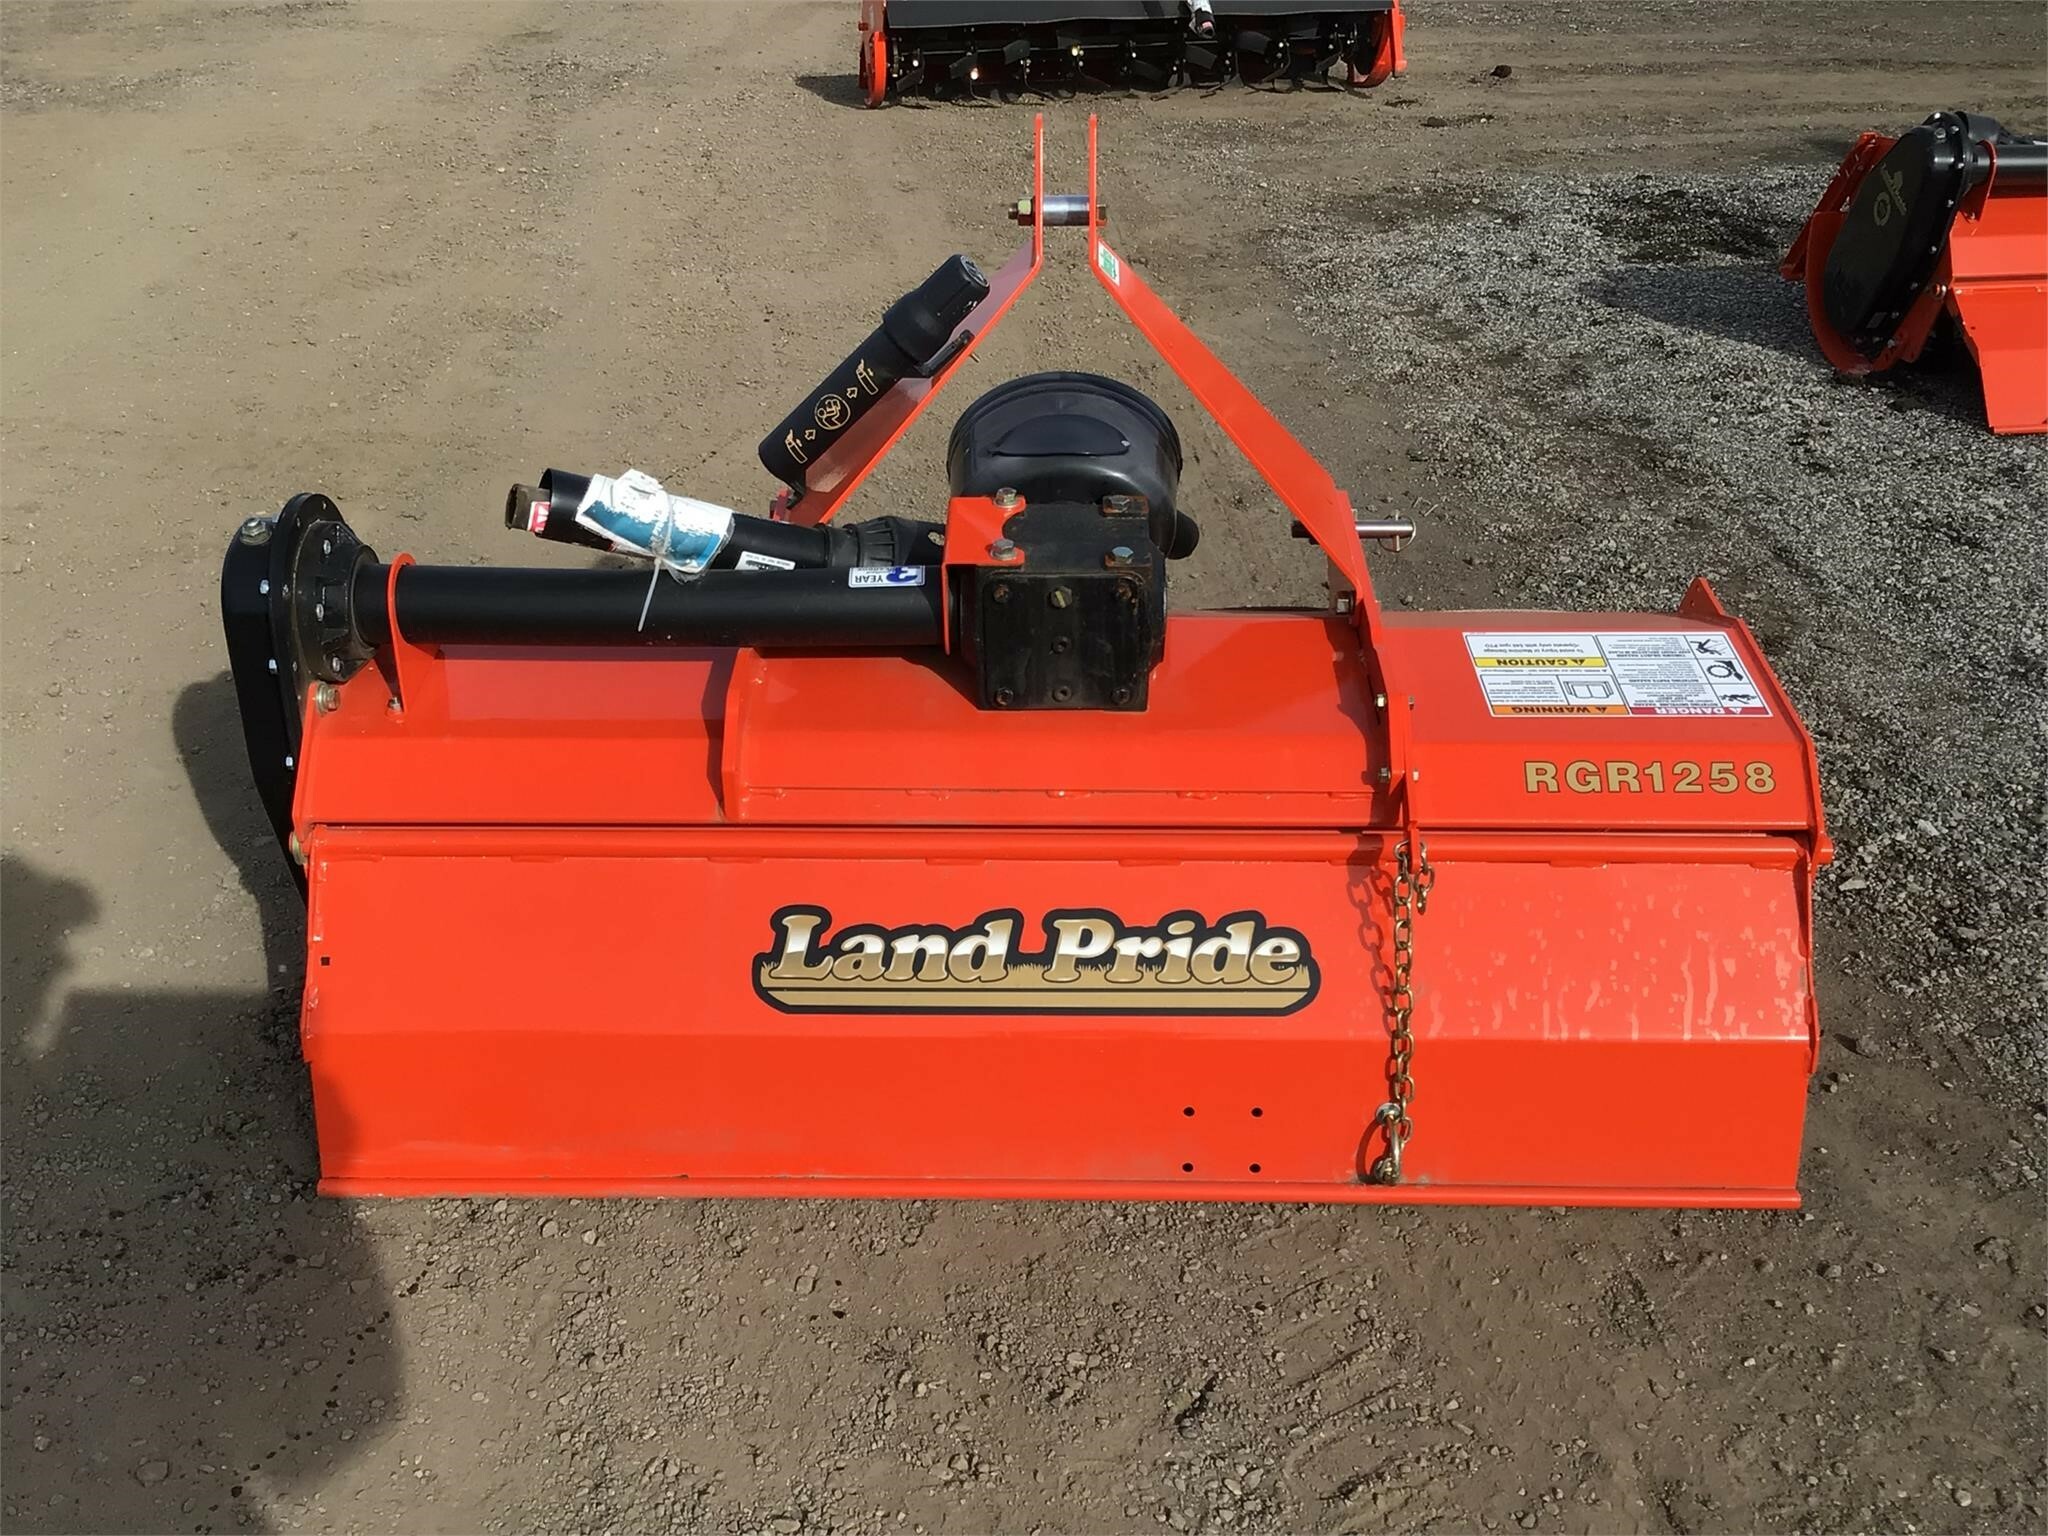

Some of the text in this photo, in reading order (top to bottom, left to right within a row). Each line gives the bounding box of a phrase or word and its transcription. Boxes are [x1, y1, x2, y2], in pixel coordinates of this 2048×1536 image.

[855, 575, 883, 583] YEAR
[1524, 760, 1776, 794] RGR1258
[768, 914, 1301, 984] Land Pride
